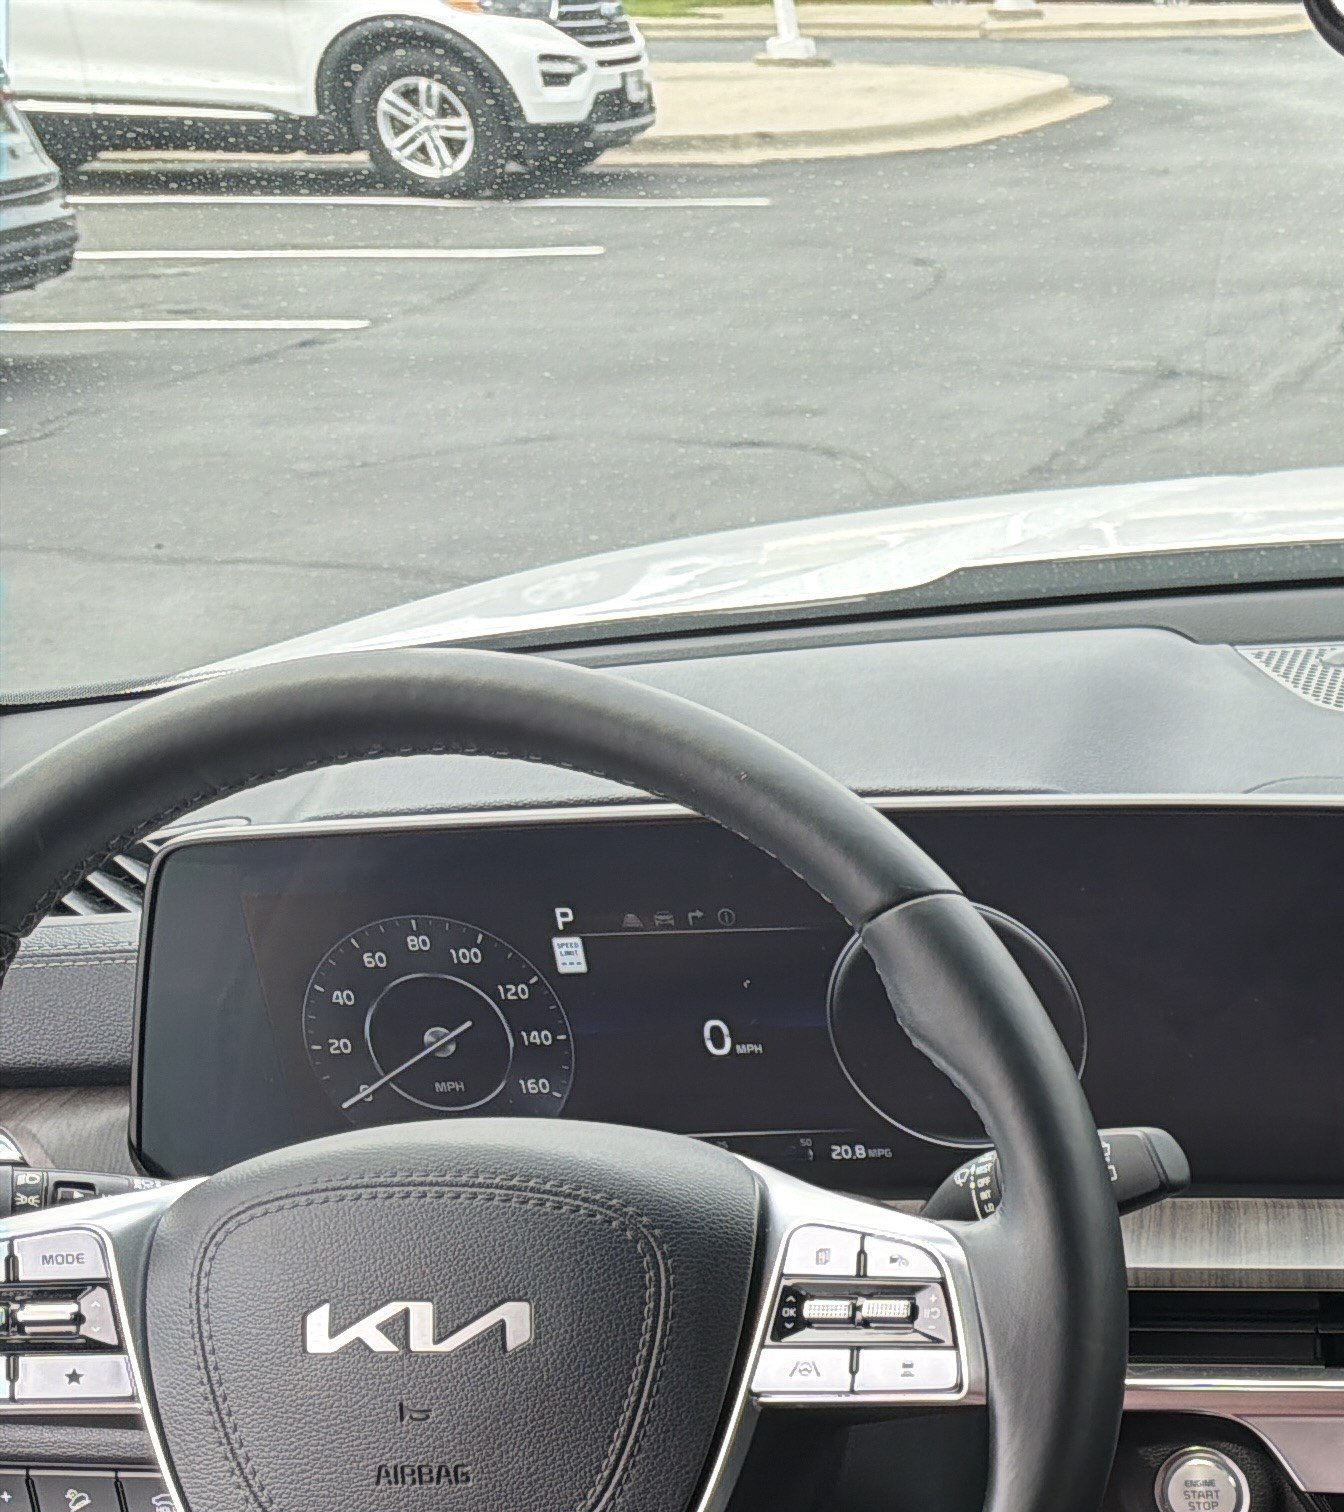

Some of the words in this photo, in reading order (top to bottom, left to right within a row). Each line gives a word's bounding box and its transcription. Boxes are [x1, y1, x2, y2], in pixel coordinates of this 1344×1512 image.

[555, 907, 574, 930] P
[407, 935, 430, 951] 80
[363, 952, 387, 968] 60
[450, 948, 482, 964] 100
[332, 990, 355, 1006] 40
[497, 984, 529, 1000] 120
[521, 1030, 552, 1046] 140
[703, 1019, 732, 1056] 0
[736, 1043, 763, 1055] MPH
[328, 1038, 351, 1054] 20
[435, 1081, 465, 1093] MPH
[519, 1078, 550, 1094] 160
[830, 1144, 866, 1160] 20.8
[868, 1148, 892, 1158] MPG
[42, 1253, 86, 1266] MODE
[781, 1307, 797, 1318] OK
[375, 1464, 471, 1486] AIRBAG
[1184, 1479, 1216, 1488] ENGINE
[1183, 1489, 1220, 1500] START
[1188, 1501, 1219, 1511] STOP
